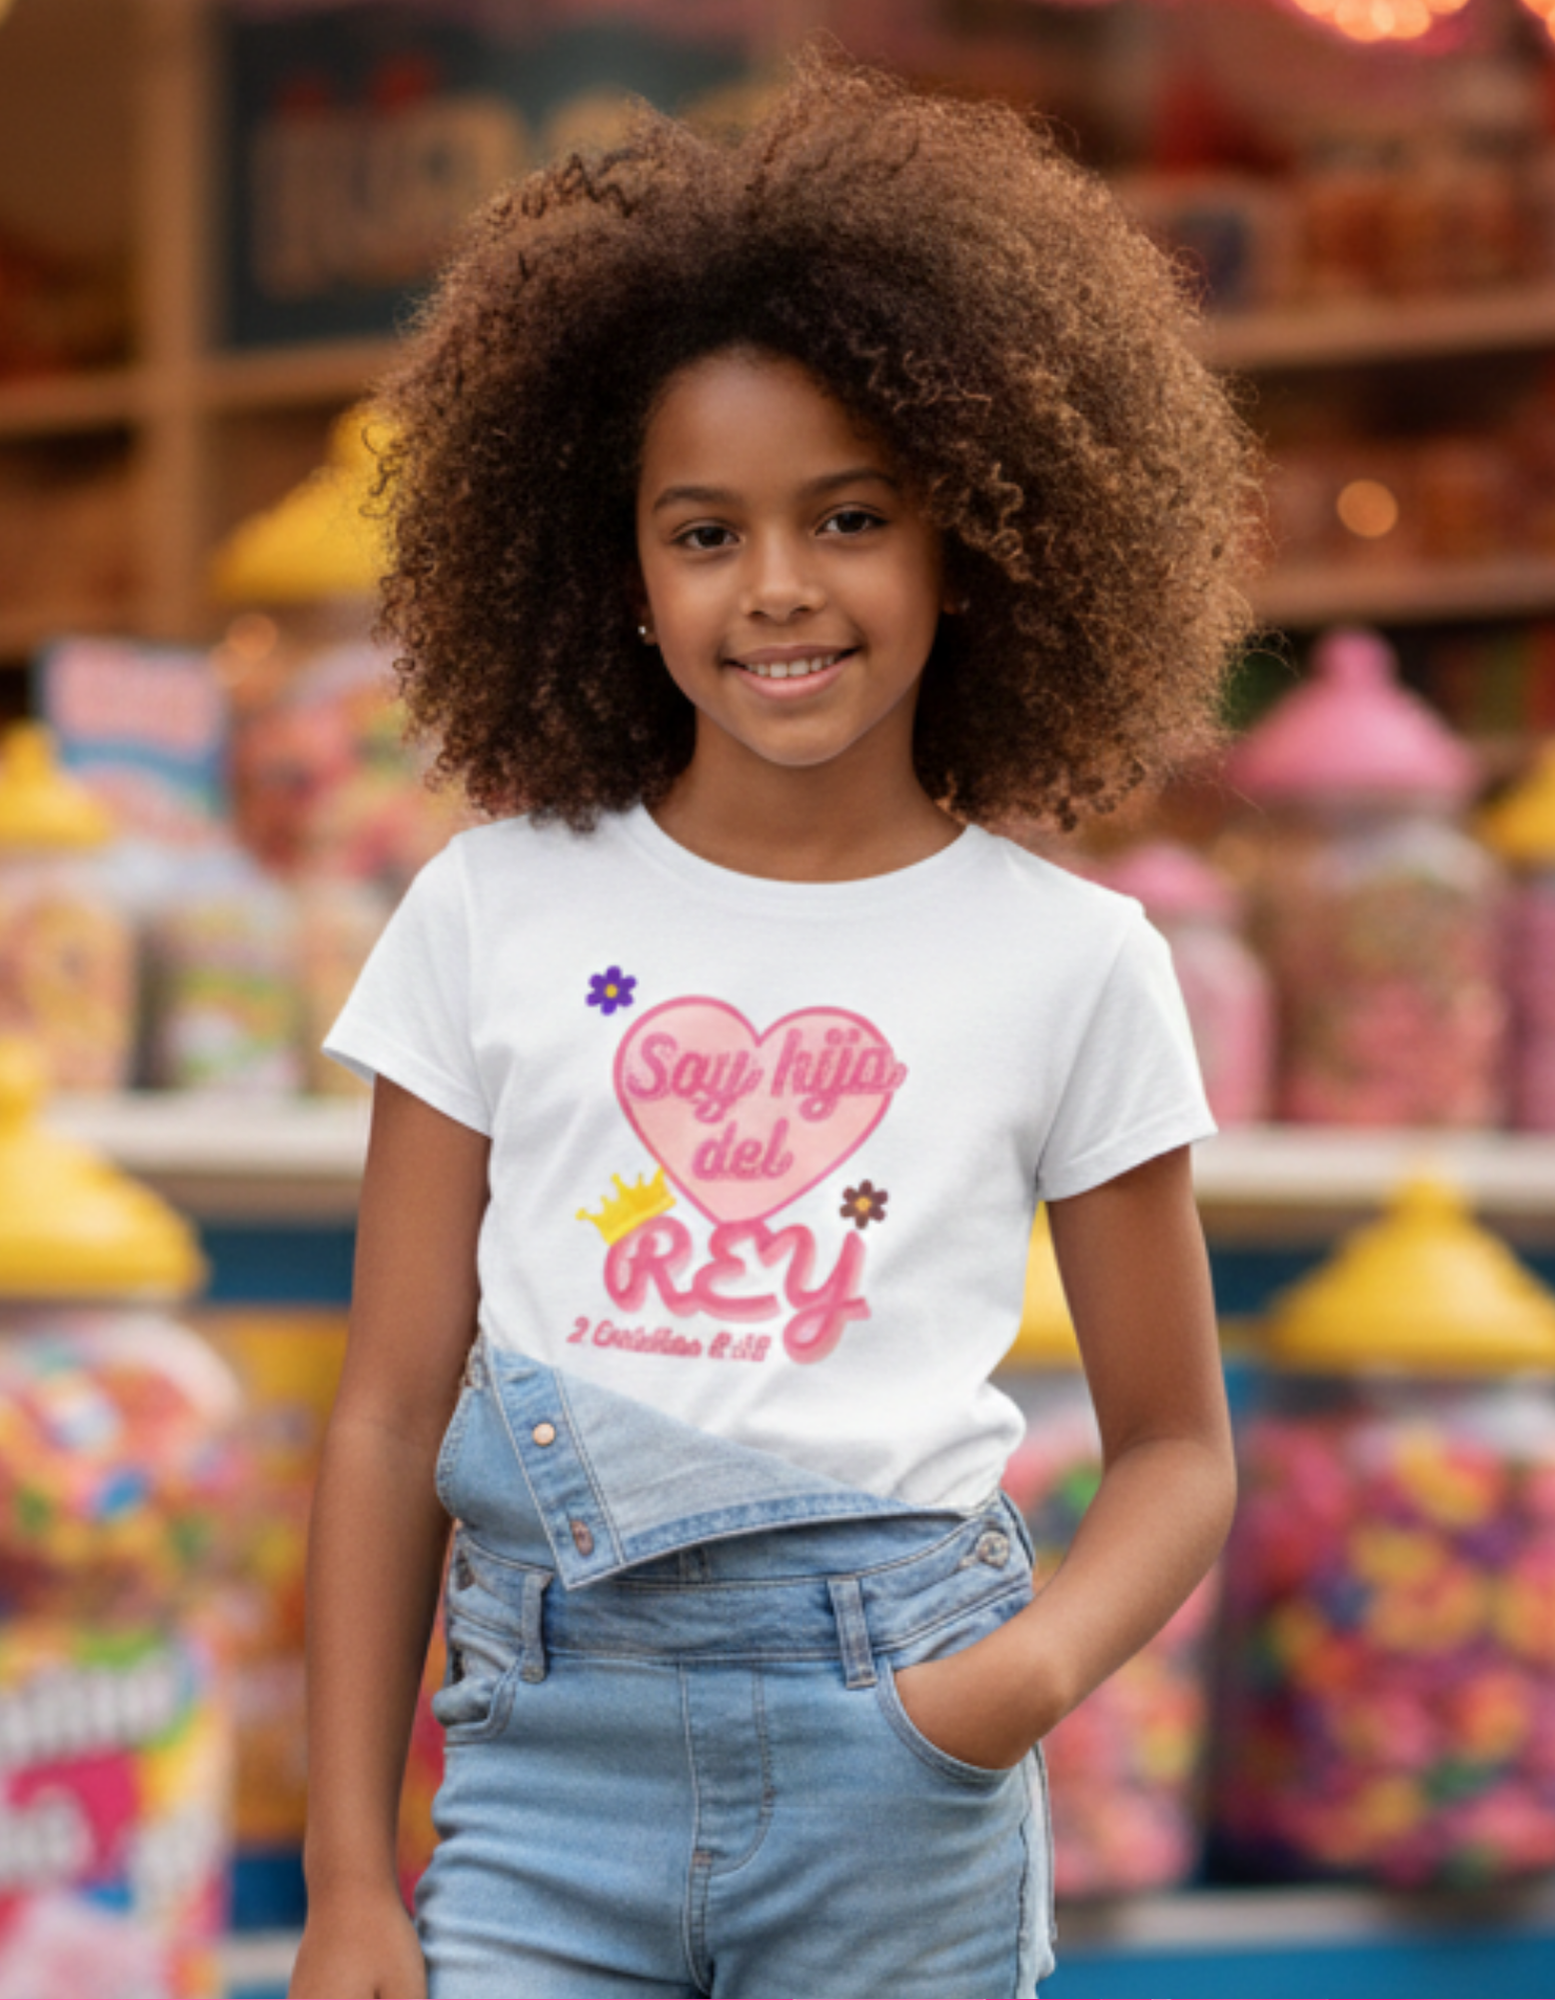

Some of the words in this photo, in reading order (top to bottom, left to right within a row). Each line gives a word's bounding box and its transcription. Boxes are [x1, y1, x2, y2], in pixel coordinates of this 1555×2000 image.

[625, 1032, 764, 1124] Soy
[770, 1028, 908, 1123] hija
[692, 1117, 794, 1181] del
[566, 1314, 591, 1344] 2
[603, 1214, 872, 1365] REY
